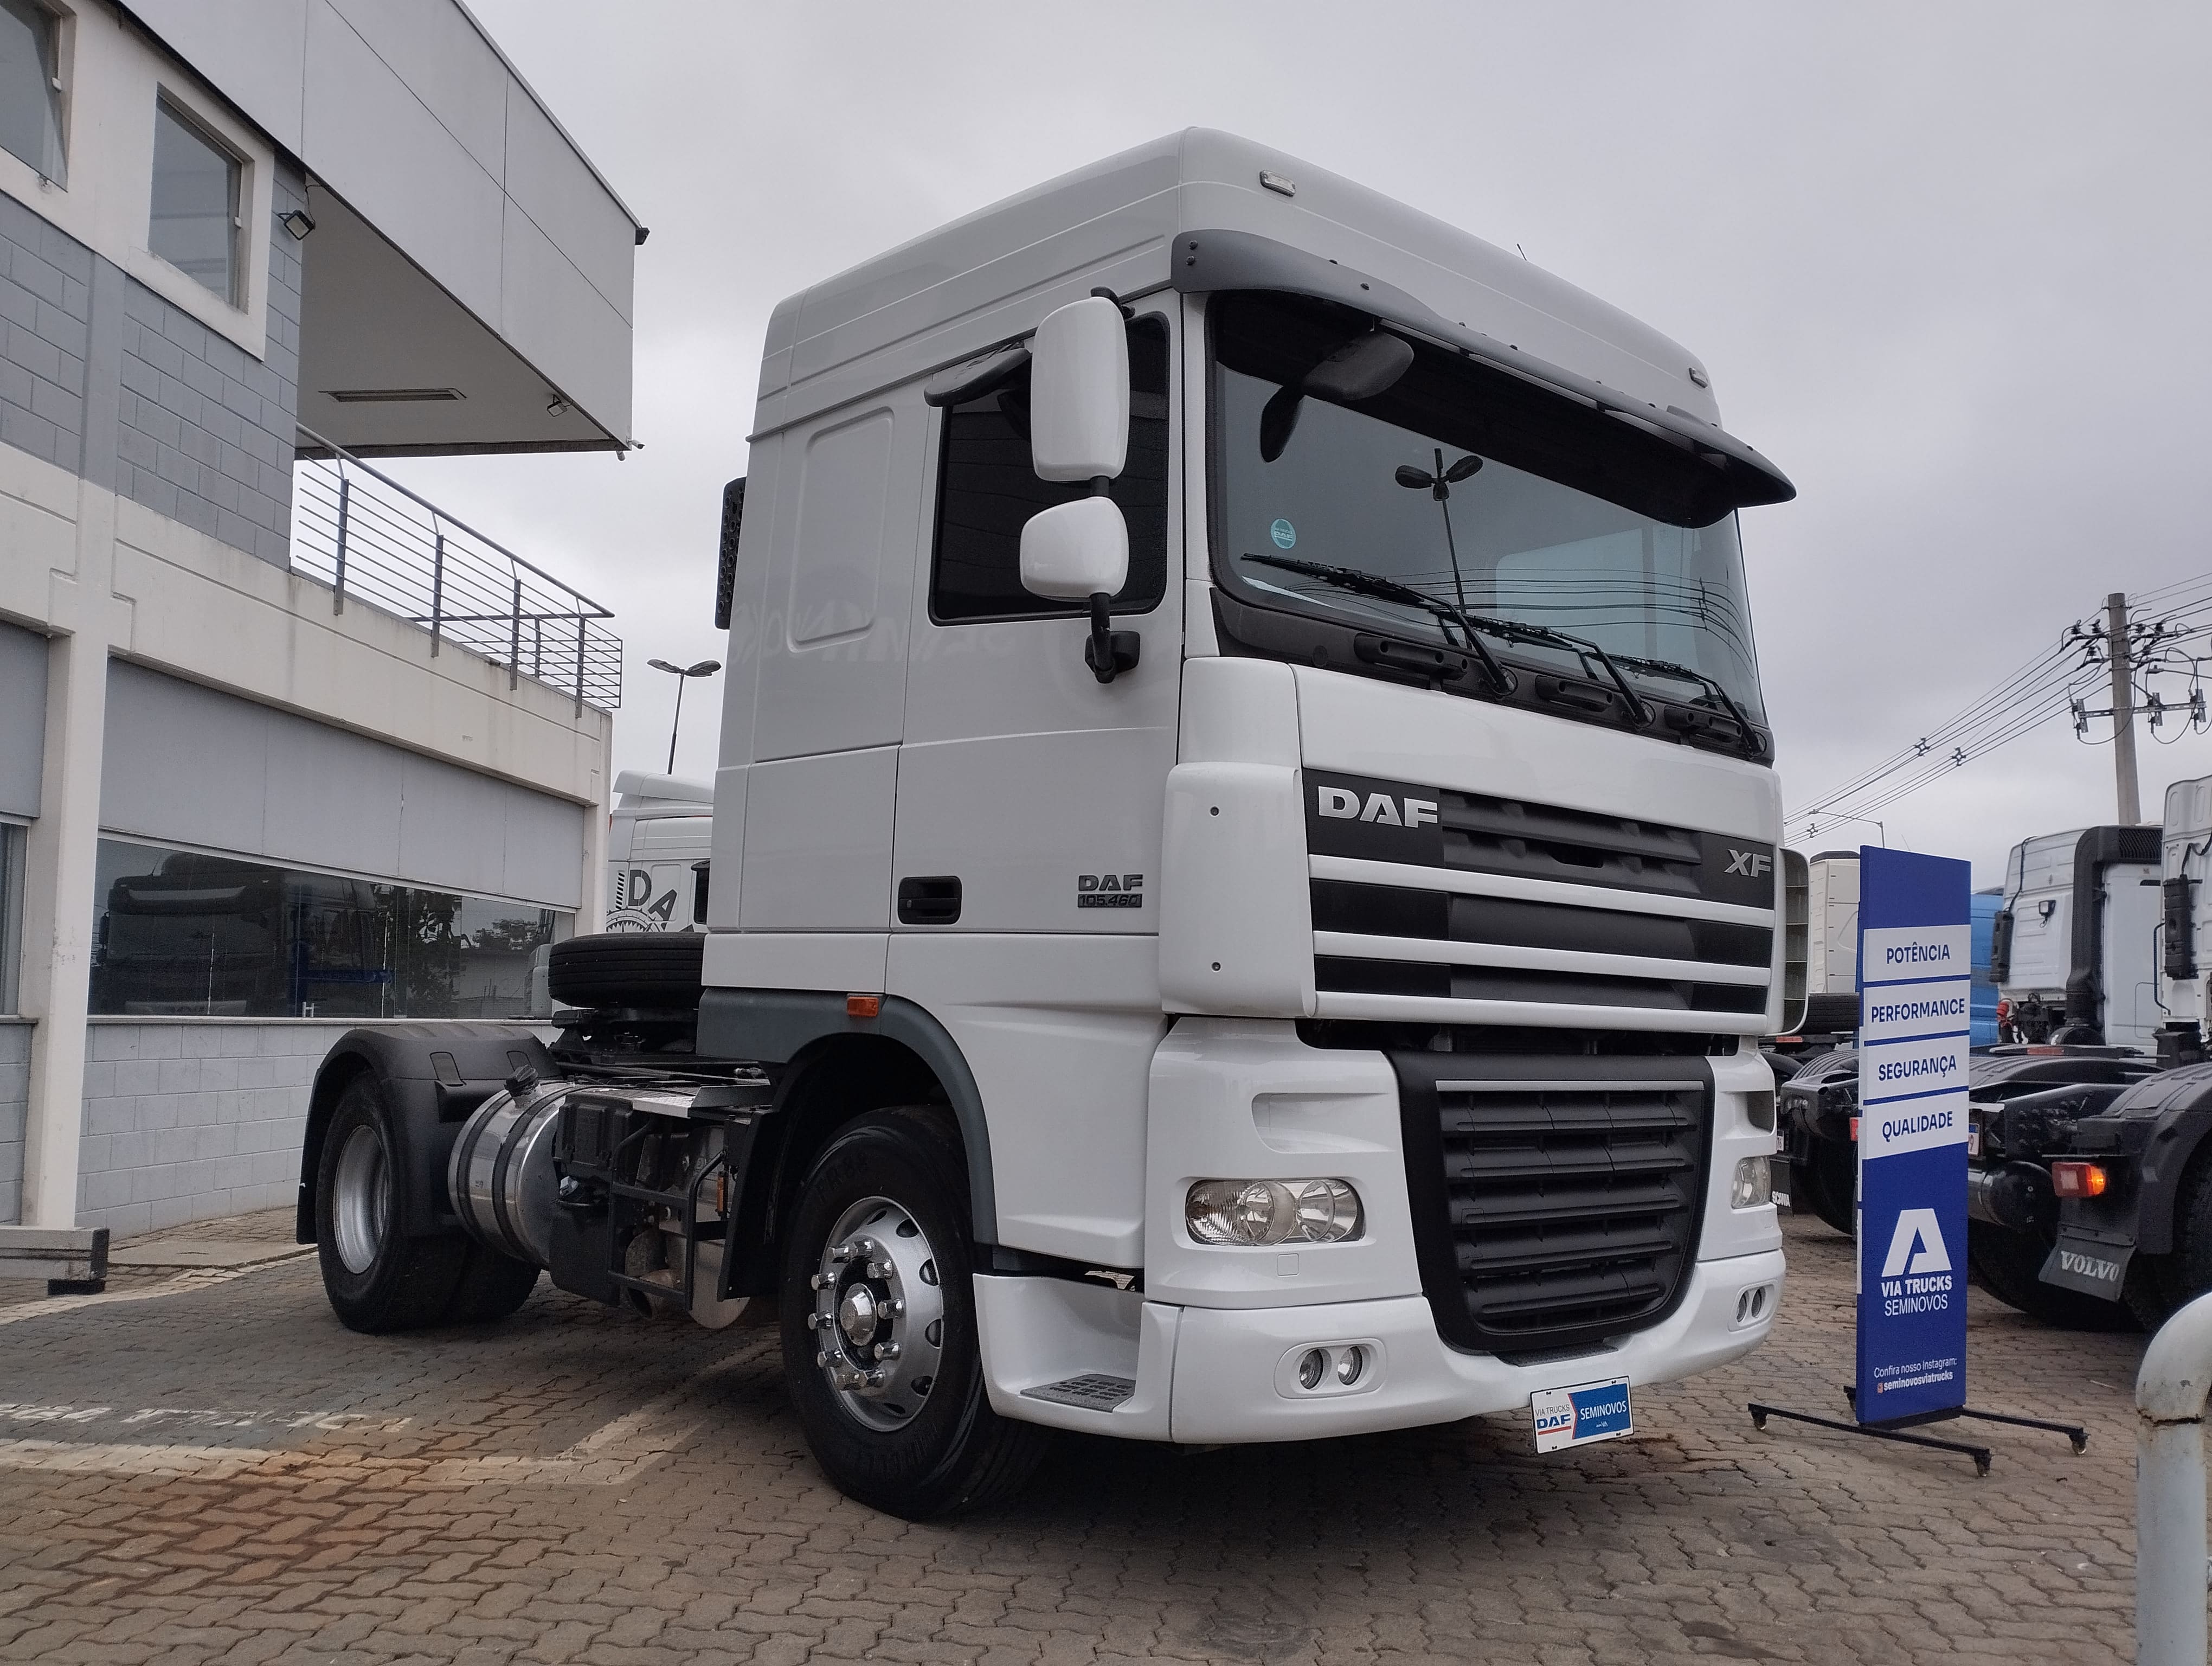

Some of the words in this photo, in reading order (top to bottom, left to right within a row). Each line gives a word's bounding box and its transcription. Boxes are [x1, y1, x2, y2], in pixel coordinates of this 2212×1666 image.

[1318, 786, 1438, 828] DAF
[1724, 849, 1771, 877] XF
[1078, 874, 1143, 891] DAF
[1078, 894, 1139, 907] 105.460
[1887, 941, 1950, 964] POTÊNCIA
[1871, 998, 1965, 1022] PERFORMANCE
[1879, 1055, 1956, 1081] SEGURANÇA
[1882, 1111, 1952, 1142] QUALIDADE
[2061, 1251, 2119, 1281] VOLVO
[1881, 1281, 1902, 1297] VIA
[1905, 1276, 1952, 1295] TRUCKS
[1885, 1294, 1948, 1317] SEMINOVOS
[1874, 1366, 1900, 1378] Confira
[1901, 1363, 1921, 1374] nosso
[1922, 1357, 1957, 1370] Instagram:
[1884, 1370, 1953, 1391] seminovosviatrucks
[1535, 1408, 1545, 1417] VIA
[1546, 1404, 1570, 1415] TRUCKS
[1536, 1414, 1571, 1429] DAF
[1580, 1401, 1626, 1420] SEMINOVOS
